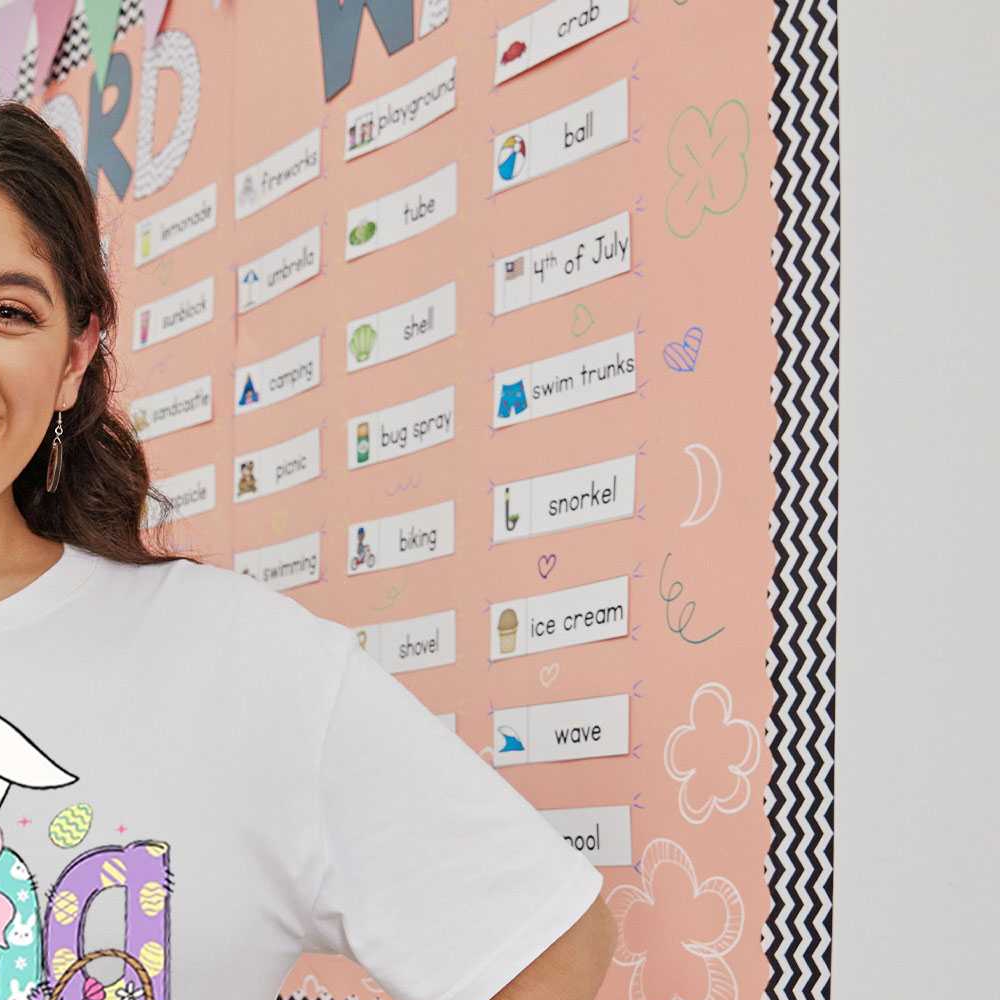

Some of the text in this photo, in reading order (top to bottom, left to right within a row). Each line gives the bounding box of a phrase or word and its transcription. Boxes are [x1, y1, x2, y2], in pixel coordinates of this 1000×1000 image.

[557, 0, 600, 38] crab
[377, 66, 456, 132] playground
[563, 111, 595, 150] ball
[261, 147, 319, 194] fireworks
[159, 199, 213, 241] lemonade
[403, 195, 437, 226] tube
[267, 246, 315, 288] umbrella
[563, 244, 585, 276] of
[591, 233, 630, 268] July
[161, 292, 207, 331] sunblock
[403, 306, 436, 342] shell
[268, 360, 315, 394] camping
[531, 353, 636, 401] swim trunks
[152, 385, 210, 423] sandcastle
[380, 409, 452, 450] bug spray
[275, 454, 308, 485] picnic
[548, 475, 618, 518] snorkel
[399, 526, 438, 556] biking
[261, 552, 318, 583] swimming
[529, 602, 625, 641] ice cream
[399, 628, 441, 661] shovel
[554, 722, 603, 746] wave
